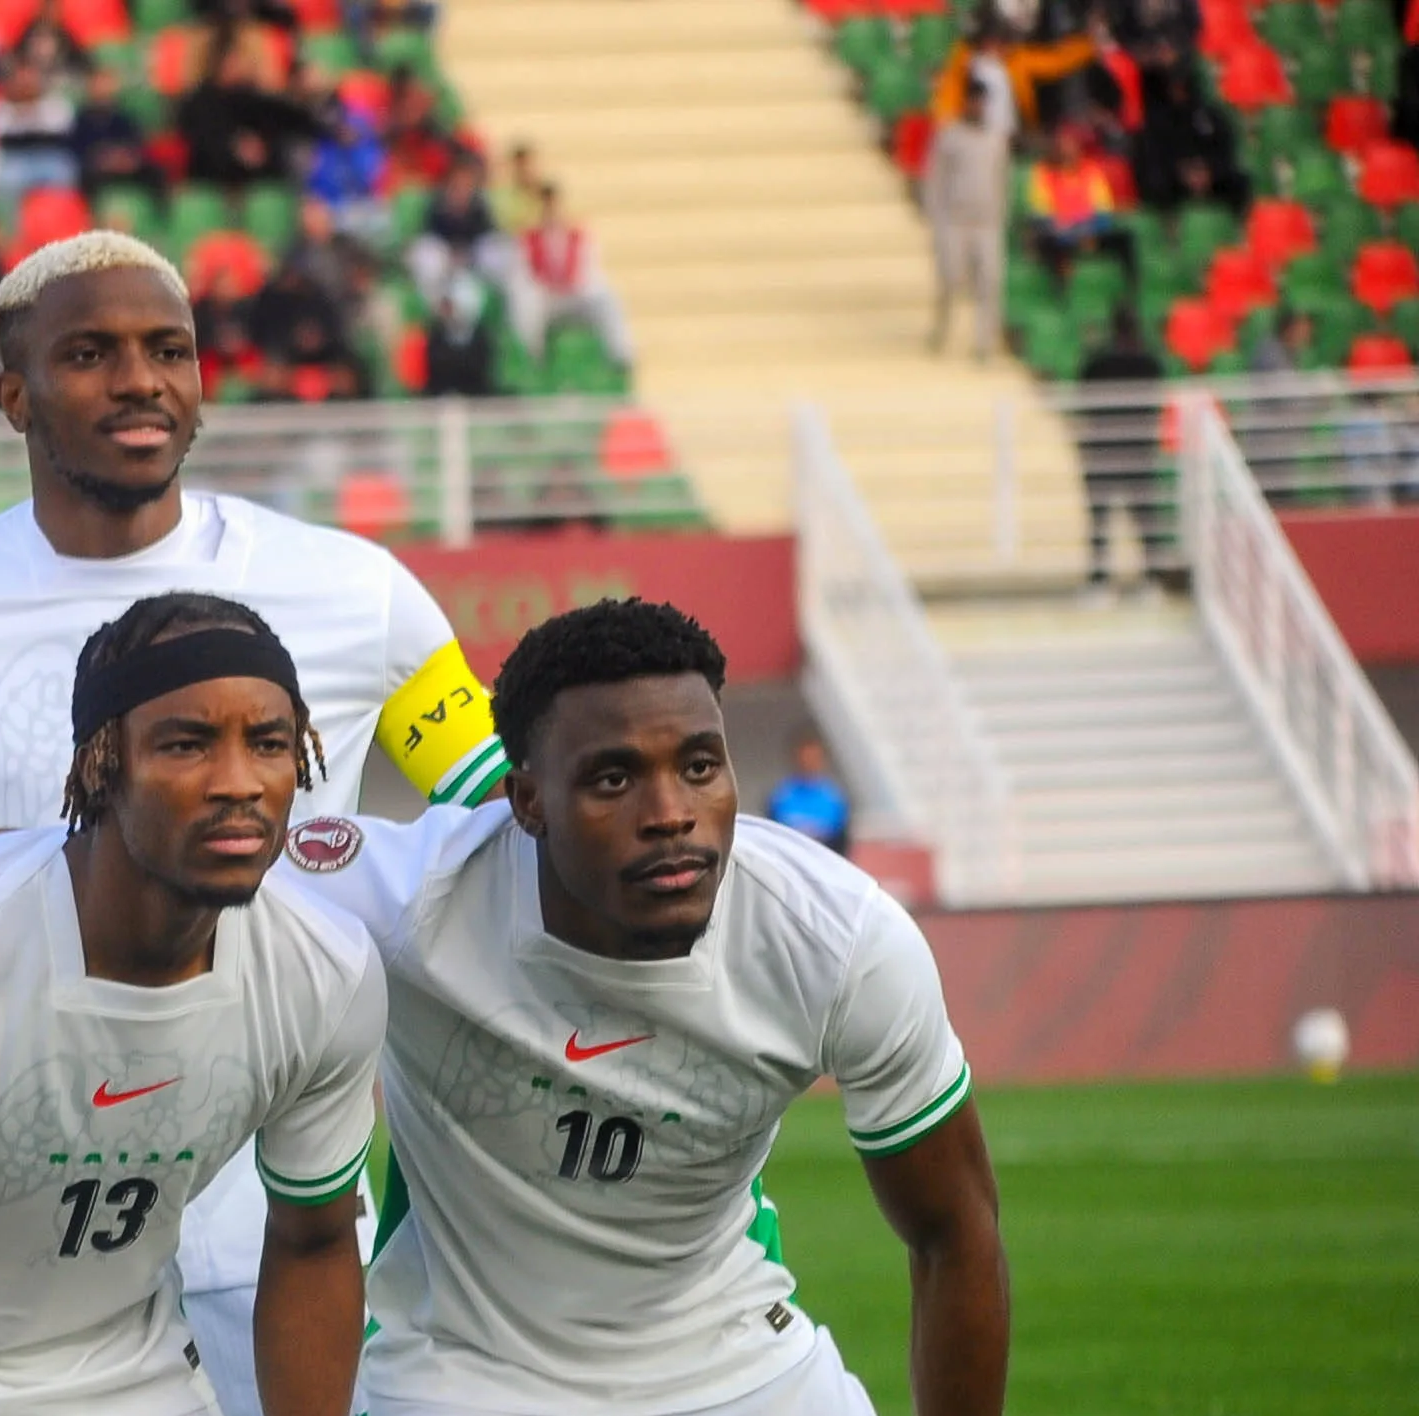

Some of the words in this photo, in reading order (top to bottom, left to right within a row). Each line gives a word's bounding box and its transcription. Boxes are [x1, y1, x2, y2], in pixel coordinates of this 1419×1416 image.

[405, 686, 474, 752] CAF
[49, 1150, 194, 1165] NAIJA
[556, 1110, 645, 1184] 10
[59, 1177, 159, 1258] 13
